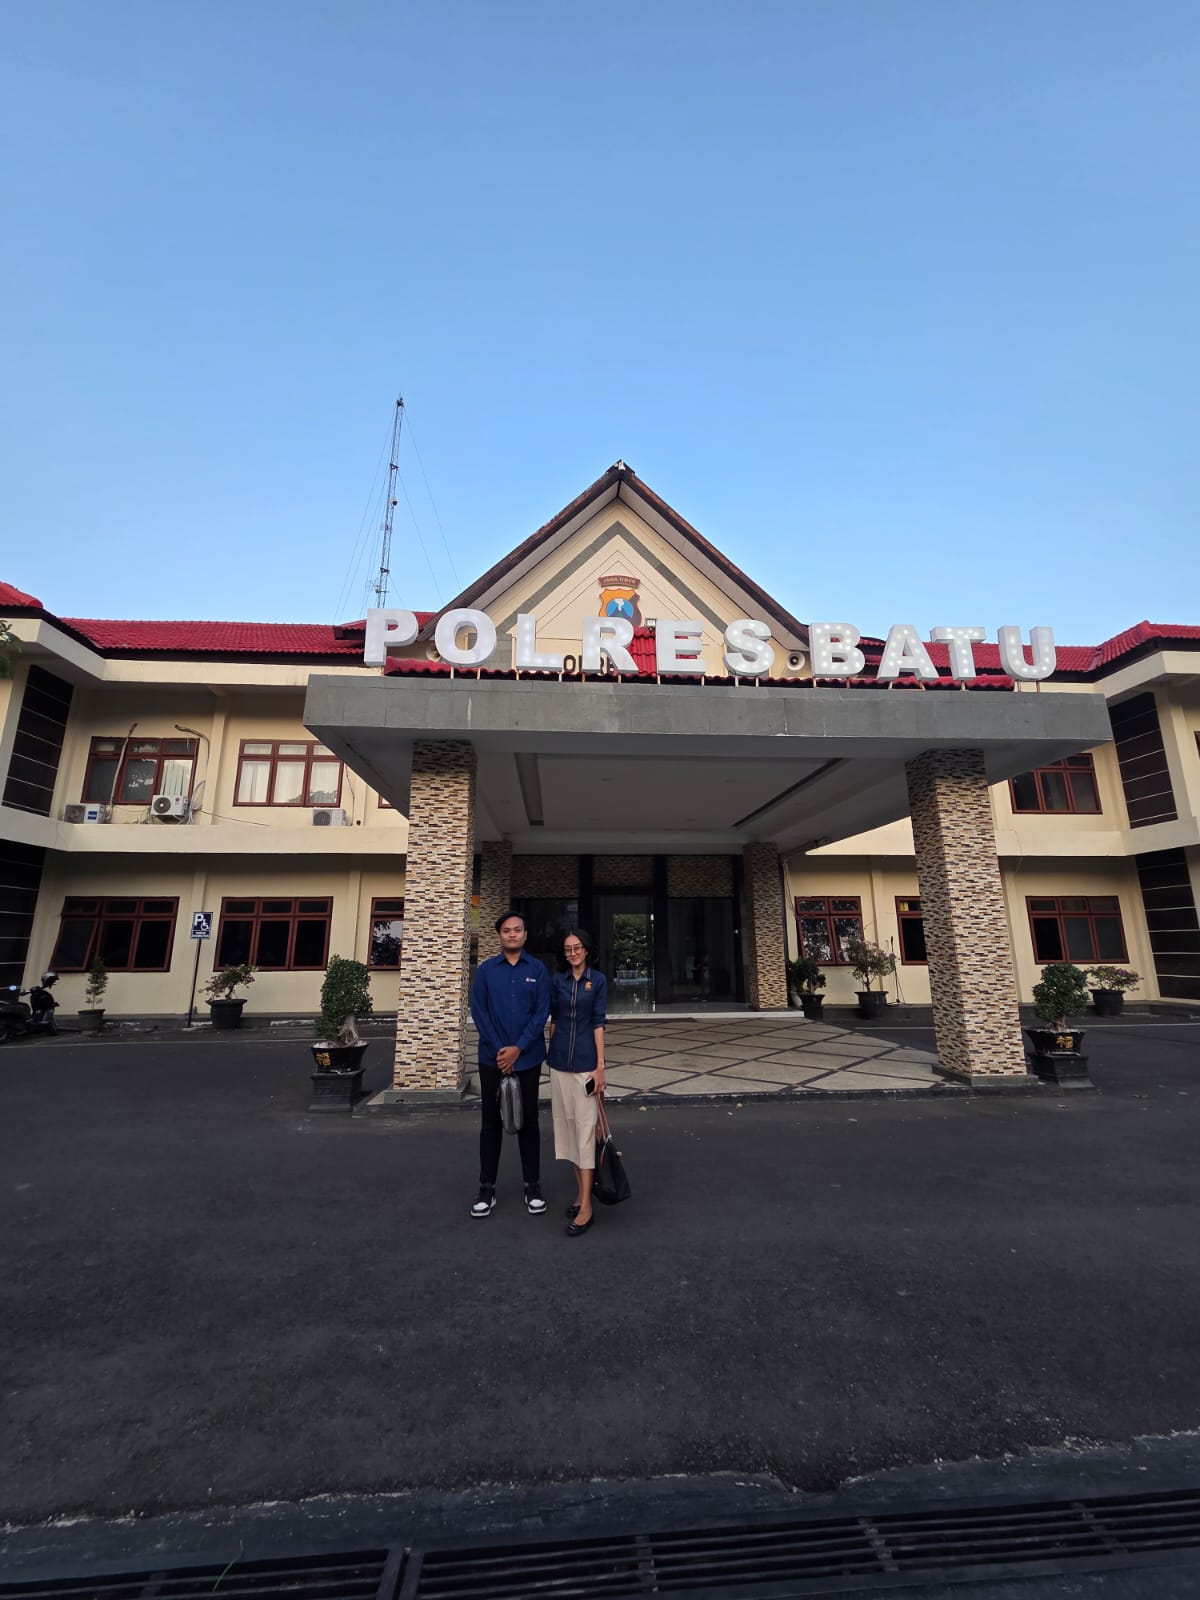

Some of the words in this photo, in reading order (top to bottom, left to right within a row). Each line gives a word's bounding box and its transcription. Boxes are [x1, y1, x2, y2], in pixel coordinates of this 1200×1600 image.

[364, 607, 775, 677] POLRES
[808, 622, 1057, 681] BATU
[194, 914, 204, 926] P
